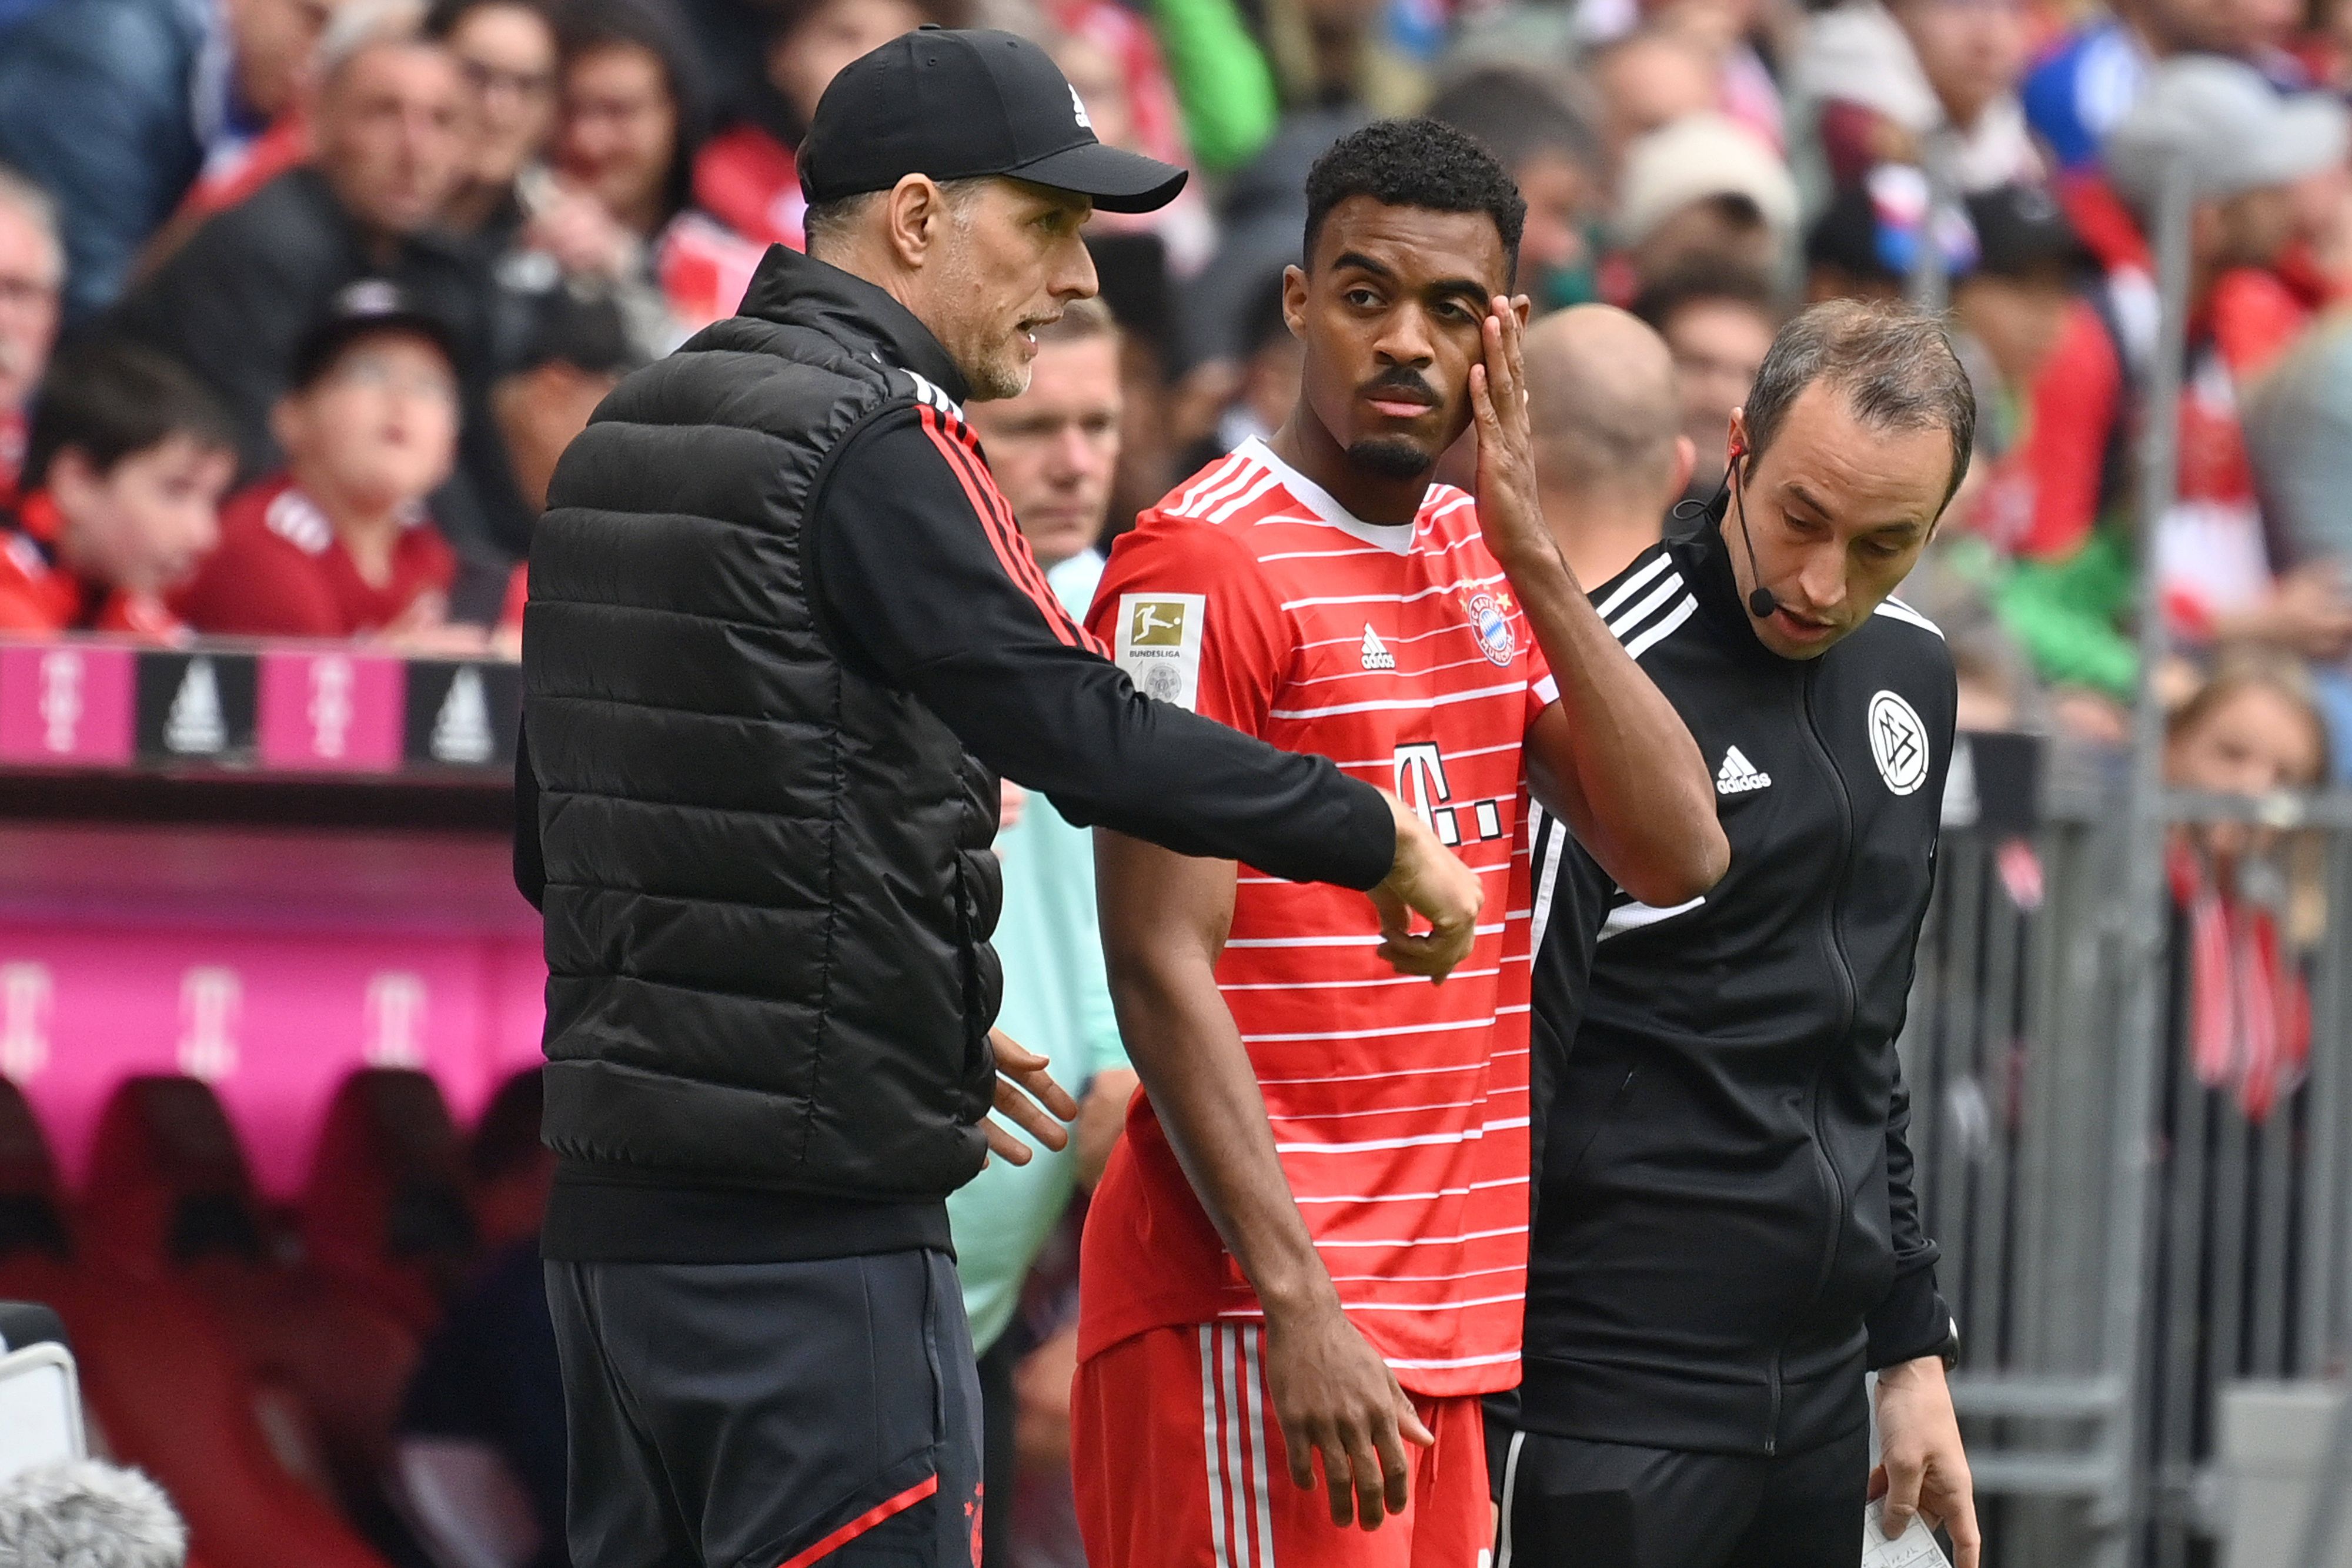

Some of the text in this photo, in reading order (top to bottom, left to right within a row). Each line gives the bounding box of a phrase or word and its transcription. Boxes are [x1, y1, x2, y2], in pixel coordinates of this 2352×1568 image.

[1471, 598, 1506, 627] FC BAYERN
[1361, 652, 1395, 670] adidas
[1716, 773, 1772, 795] adidas
